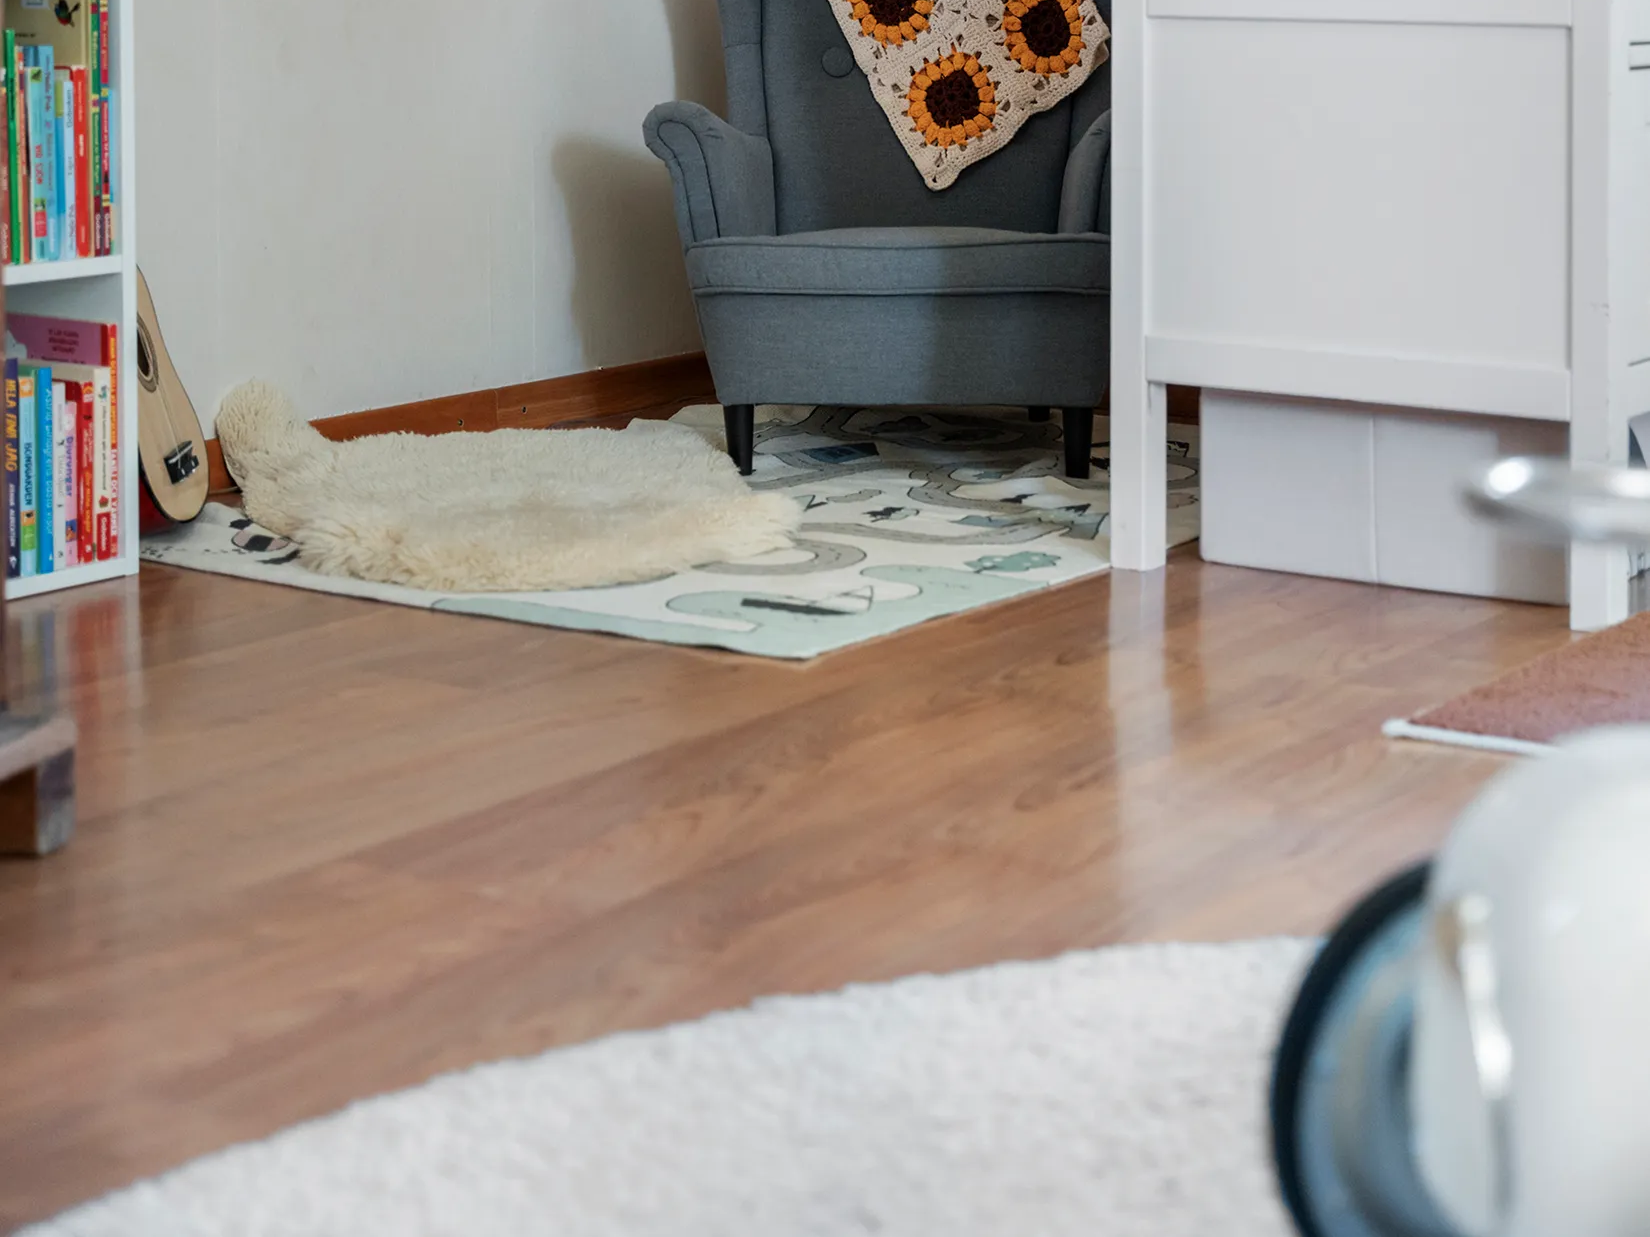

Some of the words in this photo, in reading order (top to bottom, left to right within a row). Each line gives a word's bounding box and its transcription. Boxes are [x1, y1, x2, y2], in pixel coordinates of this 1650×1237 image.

[5, 378, 17, 408] HELA
[4, 442, 18, 471] JAG
[64, 436, 74, 497] Djurungar
